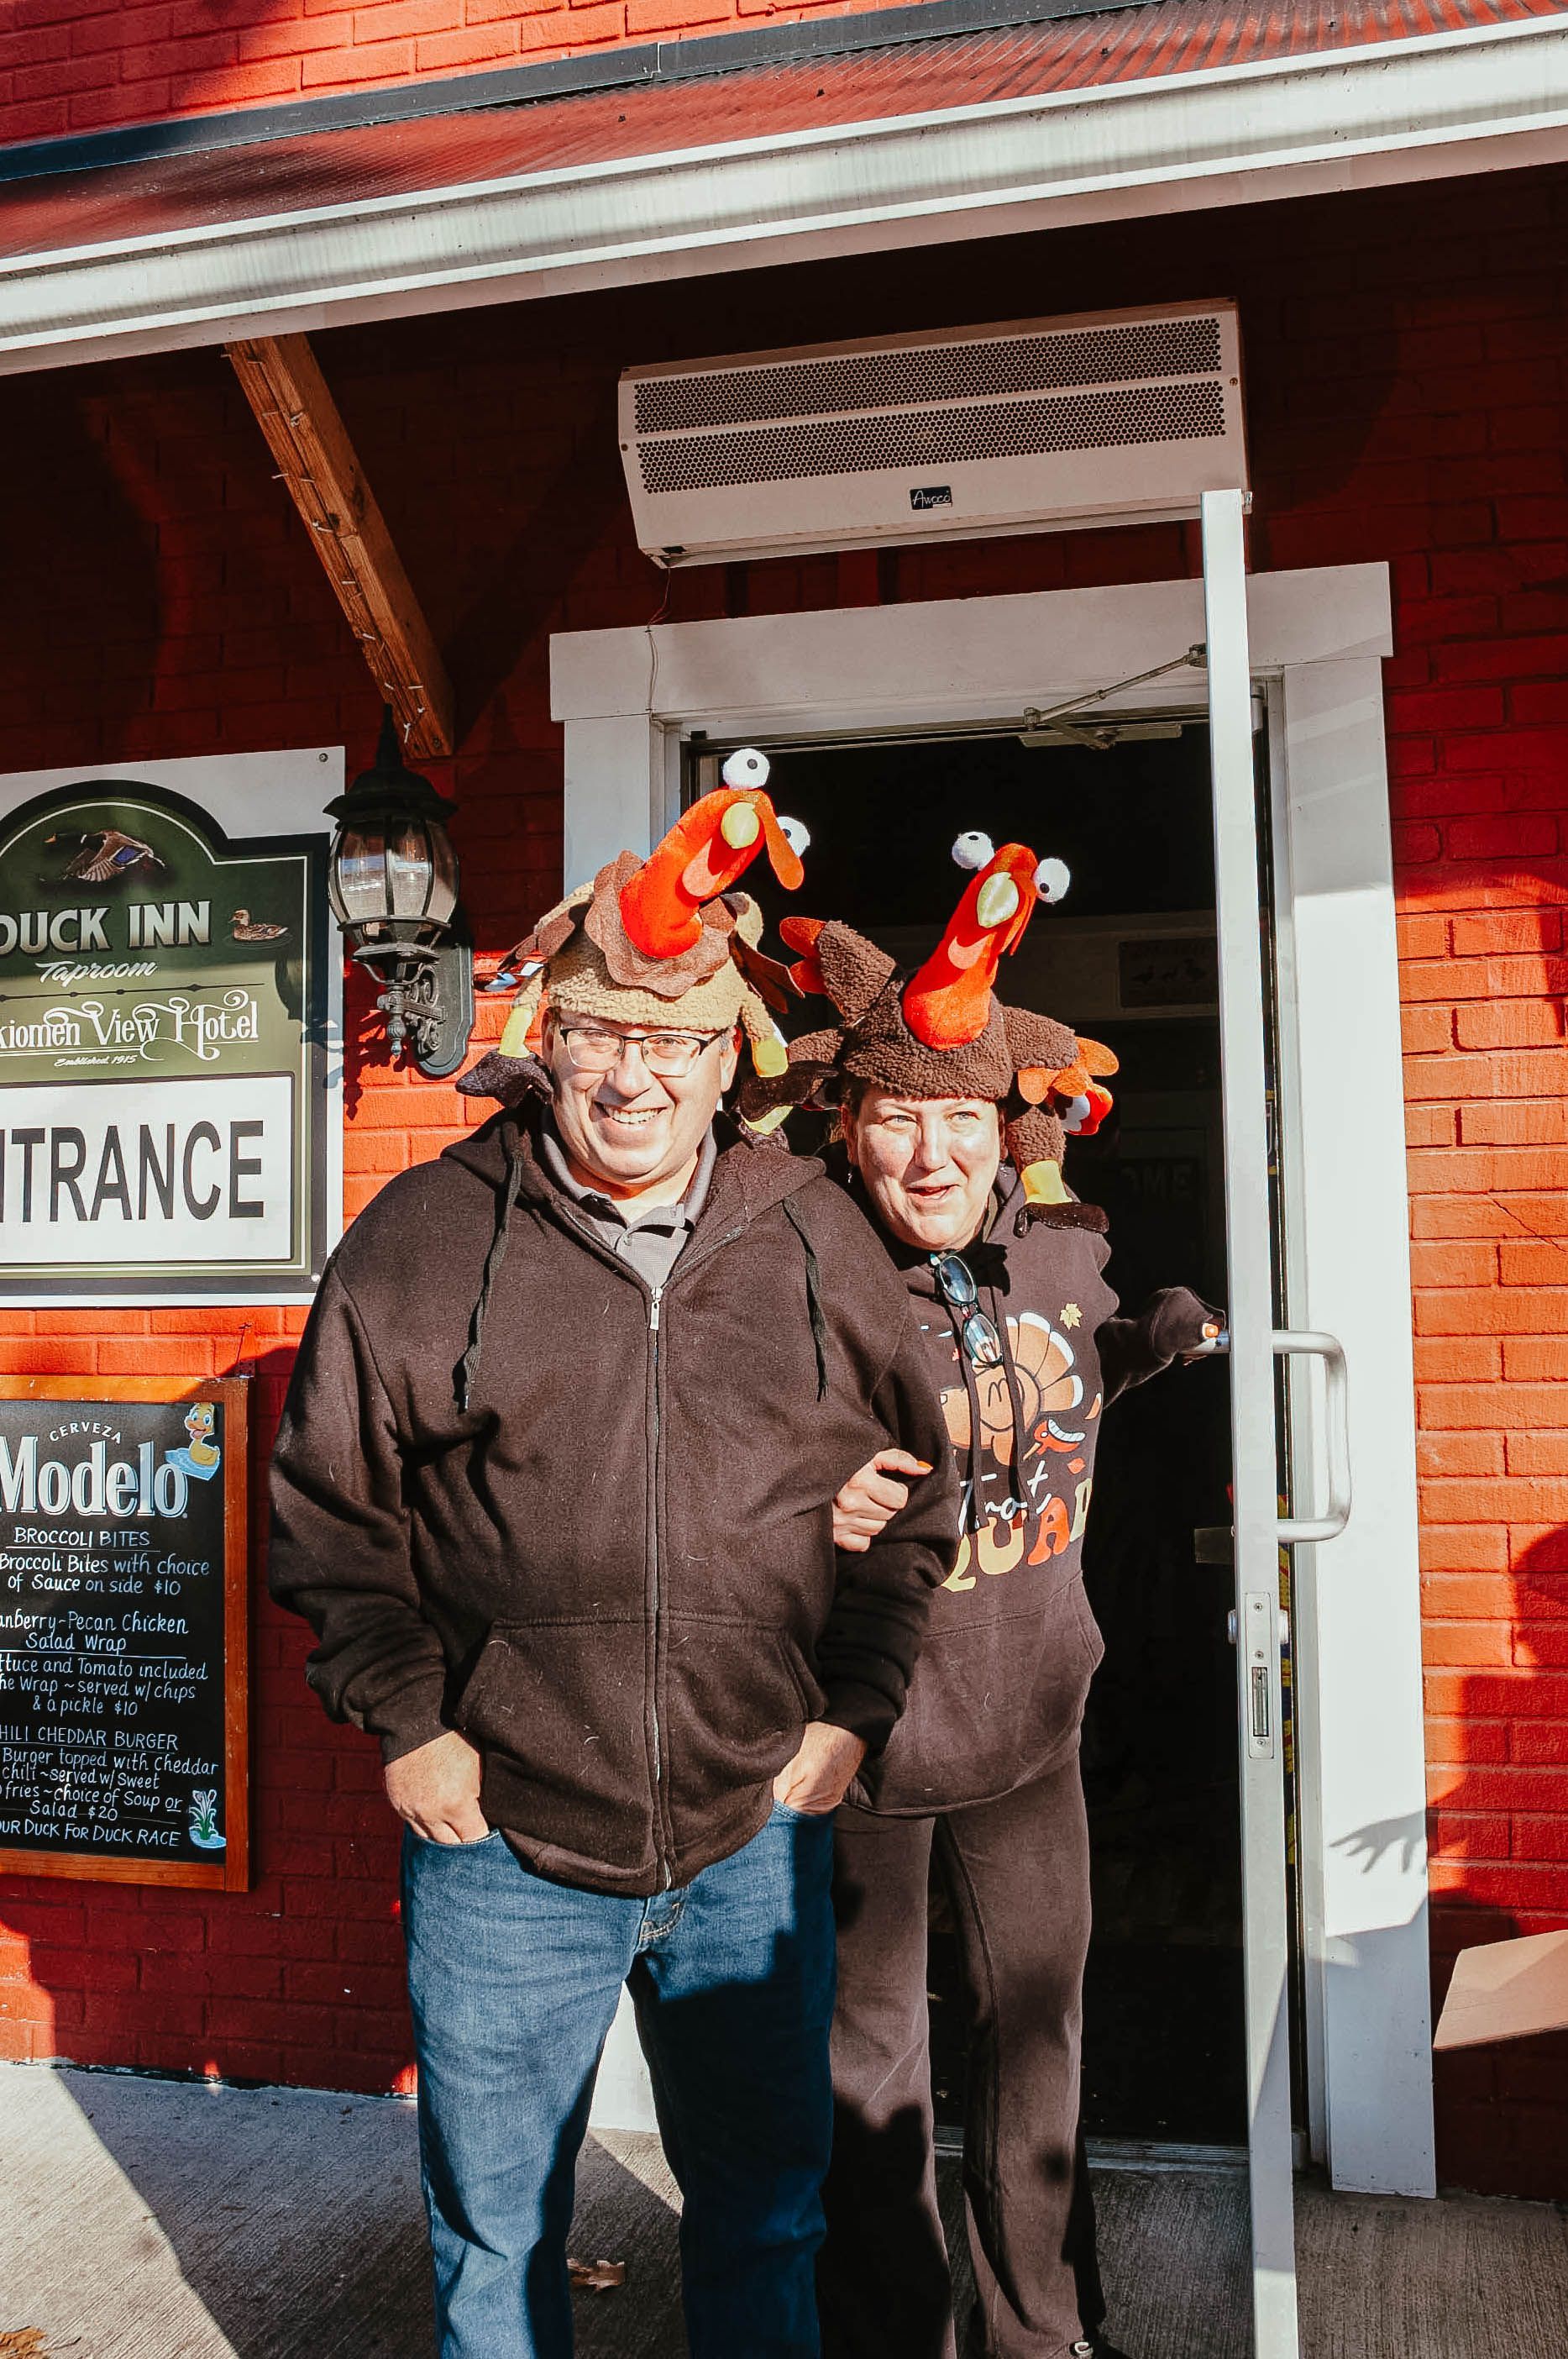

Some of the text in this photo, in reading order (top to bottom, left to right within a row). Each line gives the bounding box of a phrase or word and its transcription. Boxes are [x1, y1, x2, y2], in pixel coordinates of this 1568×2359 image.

[128, 900, 211, 950] INN
[35, 960, 158, 987] Taproom
[81, 1001, 160, 1046] View
[168, 990, 259, 1060] Hotel
[111, 1054, 138, 1064] 1915
[49, 1421, 122, 1444] CERVEZA
[0, 1435, 188, 1518] Modelo
[13, 1526, 151, 1547] BROCCOLI BITES
[68, 1553, 108, 1574] Bites
[113, 1553, 152, 1575] with
[157, 1553, 210, 1576] choice
[8, 1573, 181, 1595] of Sauce on side $10
[122, 1610, 189, 1634] Chicken
[26, 1631, 127, 1655] Salad Wrap
[43, 1657, 74, 1673] and
[78, 1658, 133, 1677] Tomato
[139, 1660, 208, 1680] included
[19, 1675, 58, 1696] Wrap
[154, 1681, 197, 1704] chips
[33, 1695, 138, 1717] & a pickle $10
[38, 1726, 107, 1747] CHEDDAR
[114, 1731, 179, 1750] BURGER
[3, 1747, 54, 1769] Burger
[60, 1747, 108, 1770] topped
[113, 1752, 149, 1771] with
[6, 1781, 40, 1799] fries
[103, 1788, 121, 1807] of
[123, 1790, 160, 1813] Soup
[165, 1799, 183, 1810] or
[29, 1799, 118, 1821] Salad $20
[136, 1828, 181, 1847] RACE
